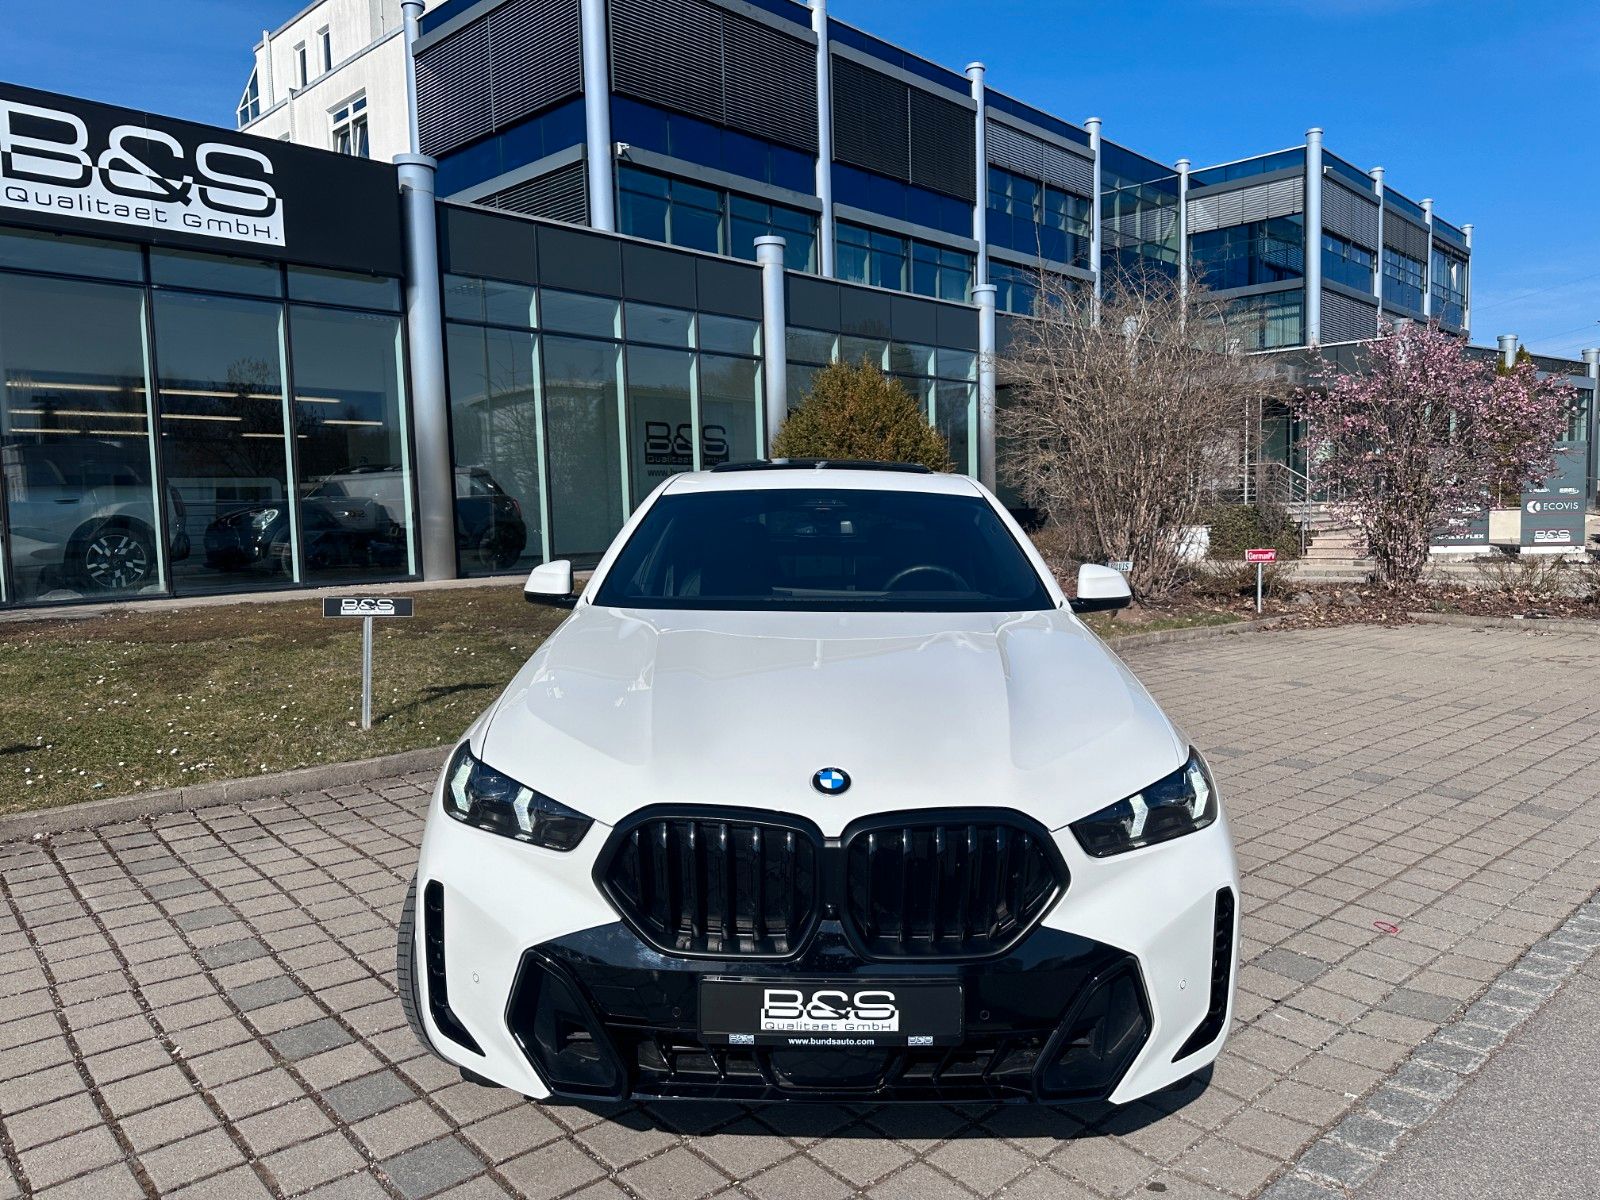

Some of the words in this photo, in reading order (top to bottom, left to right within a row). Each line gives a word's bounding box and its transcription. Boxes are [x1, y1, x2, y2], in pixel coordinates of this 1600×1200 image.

[0, 100, 276, 218] B&S
[5, 186, 168, 223] Qualitaet
[183, 213, 279, 240] GmbH.
[645, 421, 728, 456] B&S
[1543, 502, 1579, 511] ECOVIS
[1534, 529, 1570, 540] B&S
[342, 599, 394, 611] B&S
[764, 989, 896, 1021] B&S
[765, 1022, 838, 1031] Qualitaet
[788, 1037, 875, 1046] www.bundsauto.com
